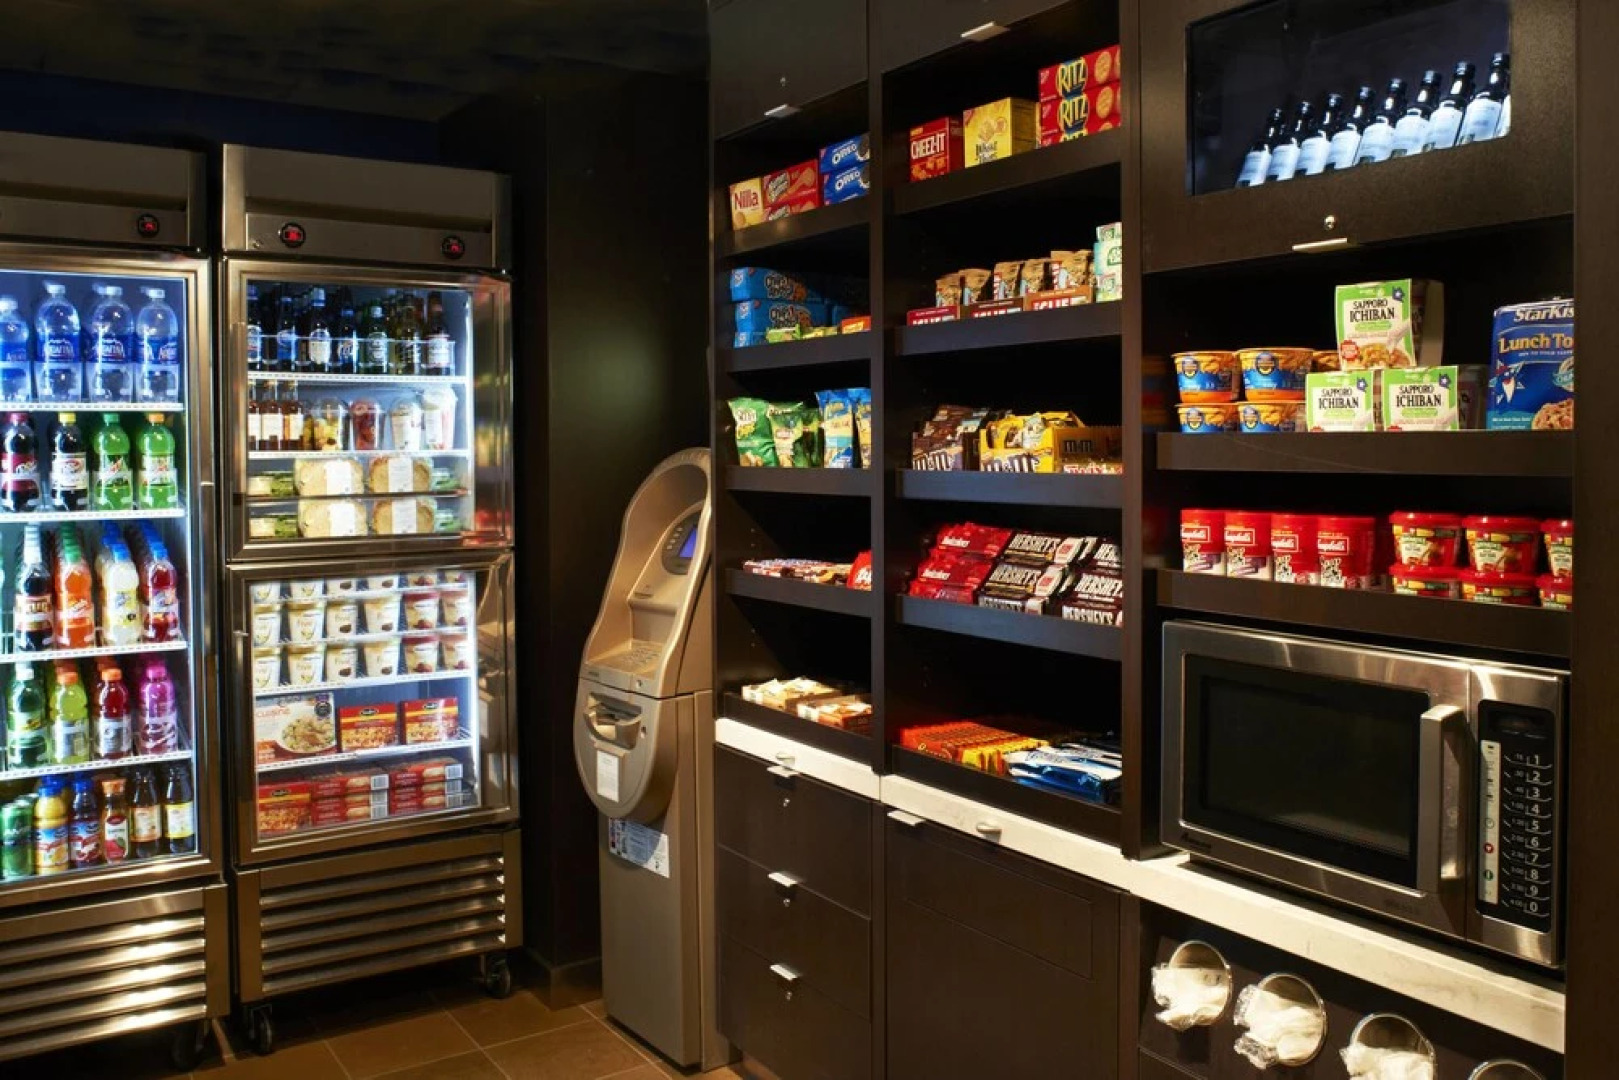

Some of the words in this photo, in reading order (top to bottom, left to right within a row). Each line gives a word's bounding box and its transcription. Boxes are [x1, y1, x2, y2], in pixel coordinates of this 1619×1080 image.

[1058, 57, 1086, 95] RITZ
[1060, 94, 1088, 129] RITZ
[832, 143, 857, 165] OREO
[835, 170, 860, 191] OREO
[734, 190, 759, 210] Nilla
[1353, 298, 1388, 310] SAPPORO
[1349, 308, 1395, 323] ICHIBAN
[1498, 333, 1551, 354] Lunch
[1552, 333, 1574, 349] To
[1321, 387, 1352, 397] SAPPORO
[1399, 385, 1435, 395] SAPPORO
[1318, 396, 1359, 410] ICHIBAN
[1396, 394, 1442, 407] ICHIBAN
[1008, 533, 1061, 553] HERSHEY'S
[989, 563, 1042, 585] HERSHEY'S
[1534, 754, 1540, 765] 1
[1532, 771, 1541, 782] 2
[1532, 787, 1540, 798] 3
[1531, 803, 1539, 815] 4
[1532, 820, 1539, 831] 5
[1531, 836, 1539, 848] 6
[1531, 852, 1539, 863] 7
[1531, 868, 1539, 880] 8
[1530, 885, 1539, 896] 9
[1529, 901, 1538, 913] 0
